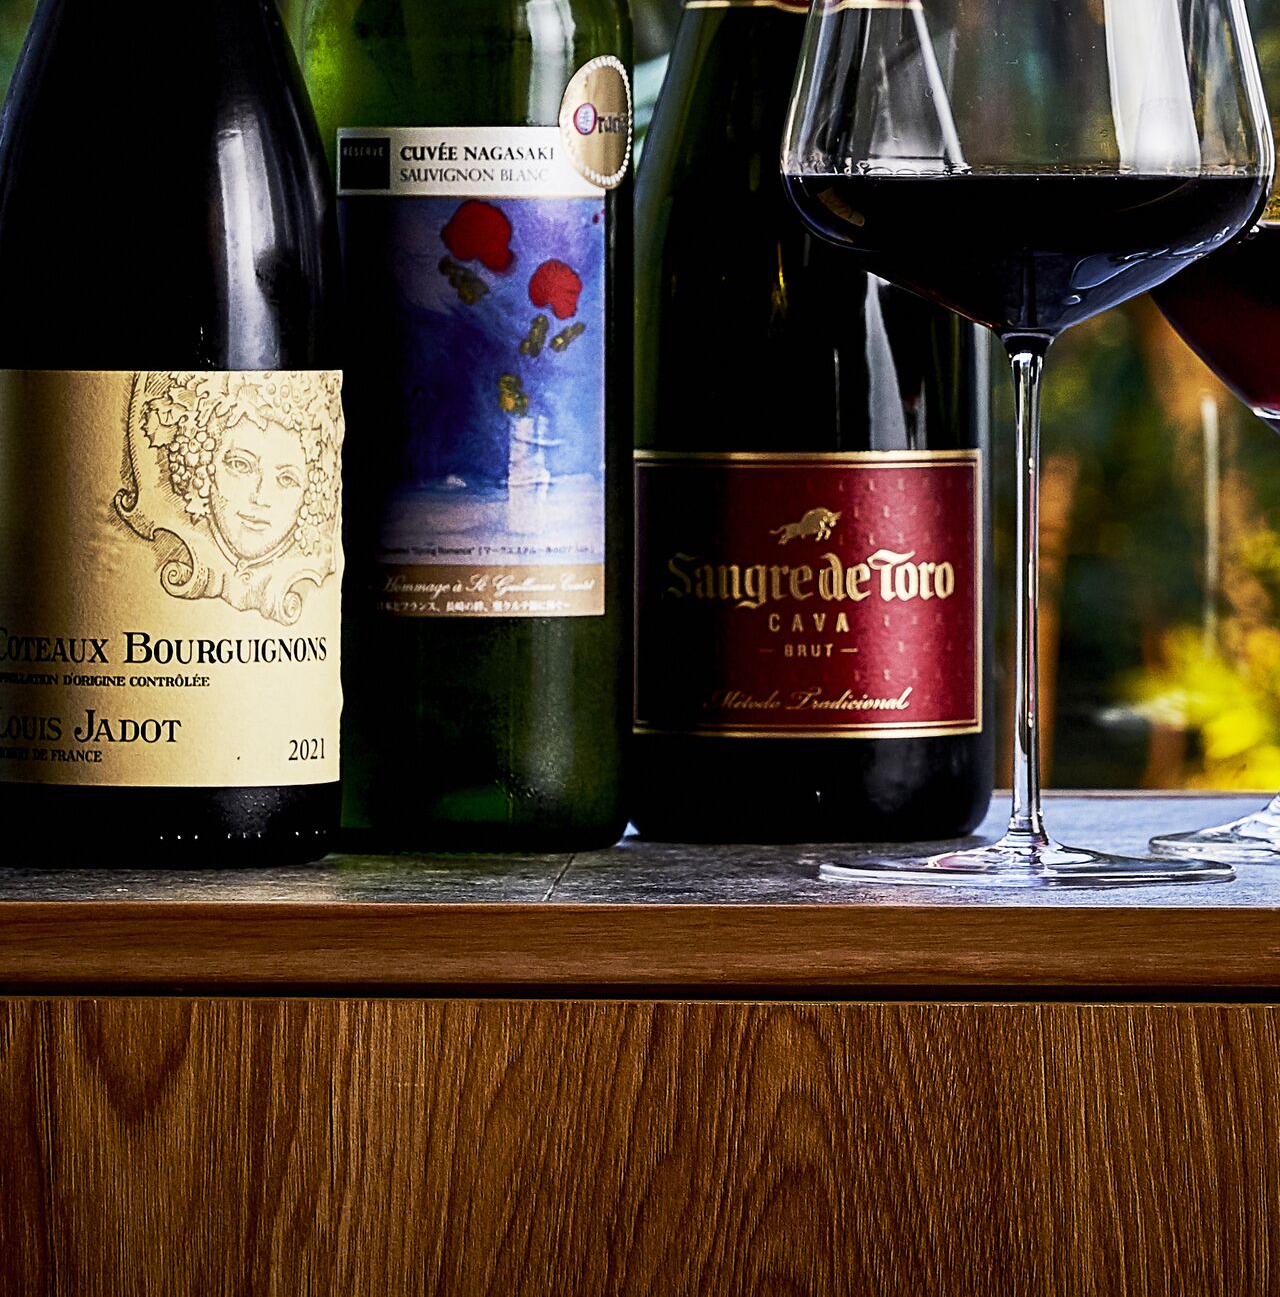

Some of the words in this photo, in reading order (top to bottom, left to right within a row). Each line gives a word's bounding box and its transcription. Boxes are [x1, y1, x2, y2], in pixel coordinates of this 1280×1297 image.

[400, 142, 457, 161] CUVÉE
[464, 145, 554, 161] NAGASAKI
[400, 167, 494, 183] SAUVIGNON
[500, 168, 548, 183] BLANC
[381, 575, 451, 599] Hommage
[451, 580, 463, 592] à
[666, 551, 815, 609] Sangre
[818, 552, 872, 602] de
[866, 549, 955, 602] Toro
[768, 612, 850, 633] CAVA
[784, 644, 834, 658] BRUT
[63, 672, 125, 687] D'ORIGINE
[129, 673, 210, 687] CONTRÔLÉE
[786, 685, 913, 711] Tradicional
[74, 709, 181, 744] JADOT
[33, 749, 48, 761] DE
[51, 749, 102, 762] FRANCE
[288, 738, 325, 761] 2021
